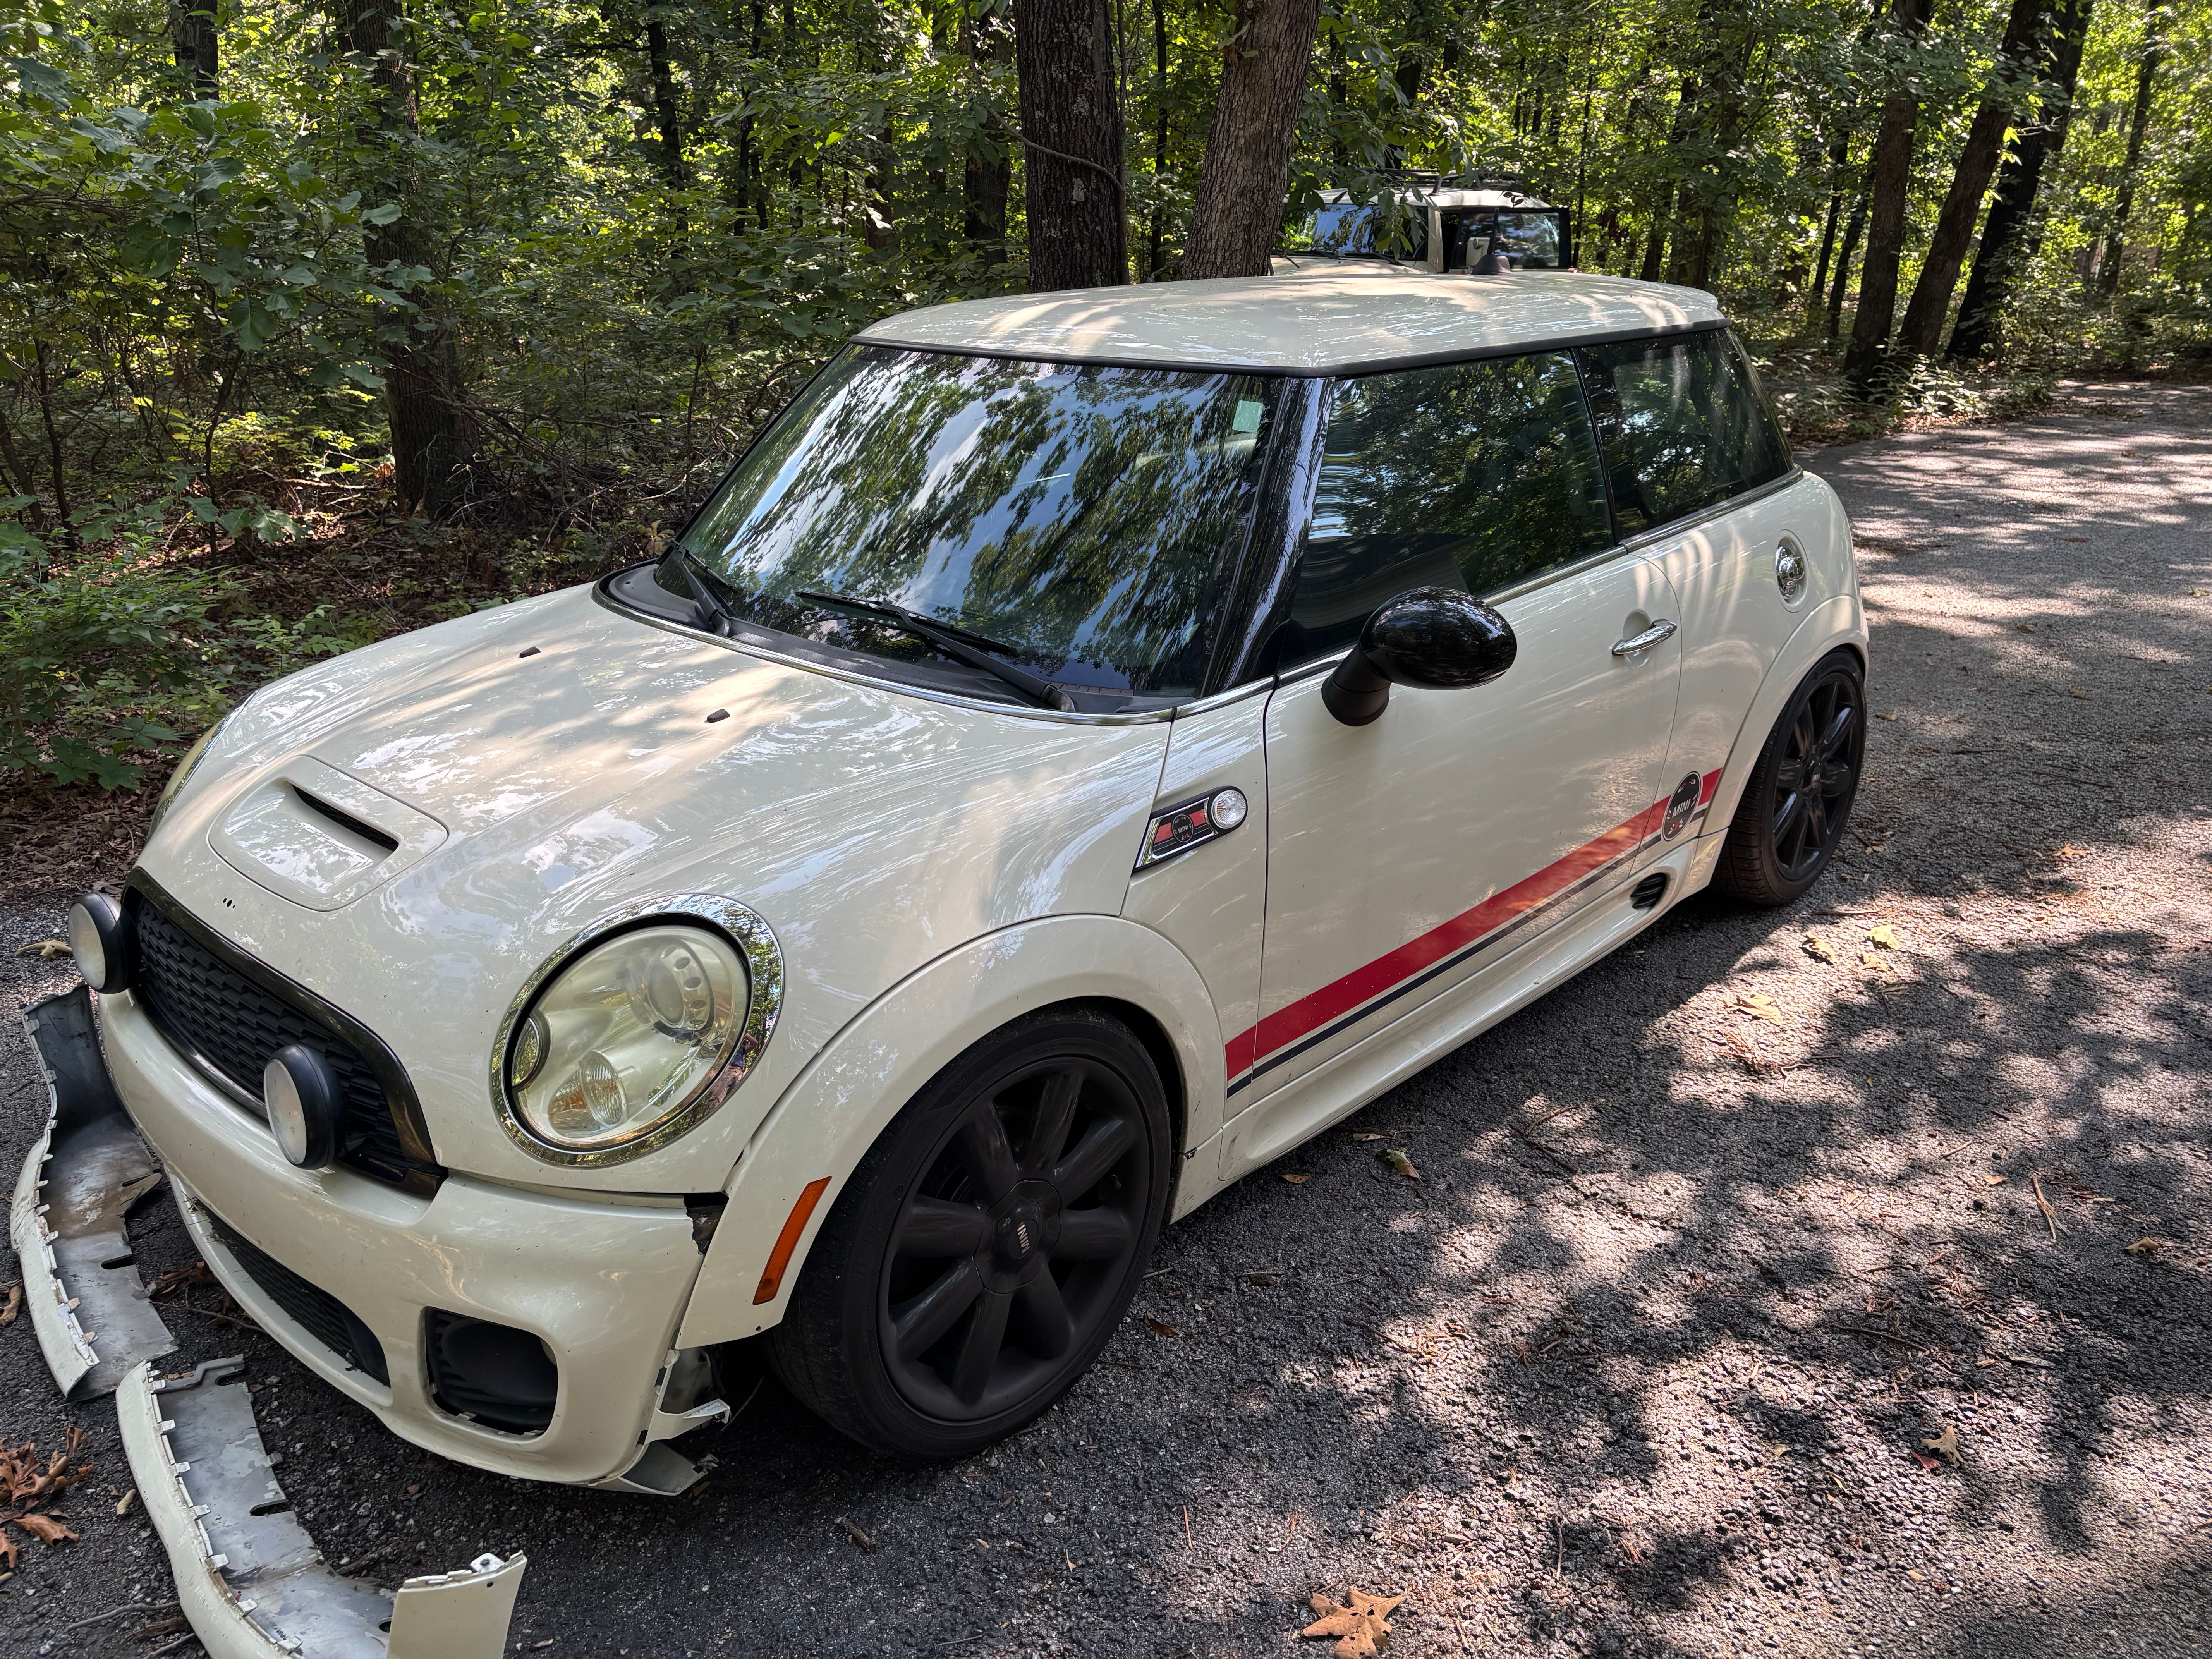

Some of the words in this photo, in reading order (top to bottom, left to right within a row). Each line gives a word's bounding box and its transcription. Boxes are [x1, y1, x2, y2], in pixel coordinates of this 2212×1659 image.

[1672, 798, 1691, 818] MINI
[1178, 825, 1189, 833] MINI
[1017, 1224, 1030, 1254] MINI
